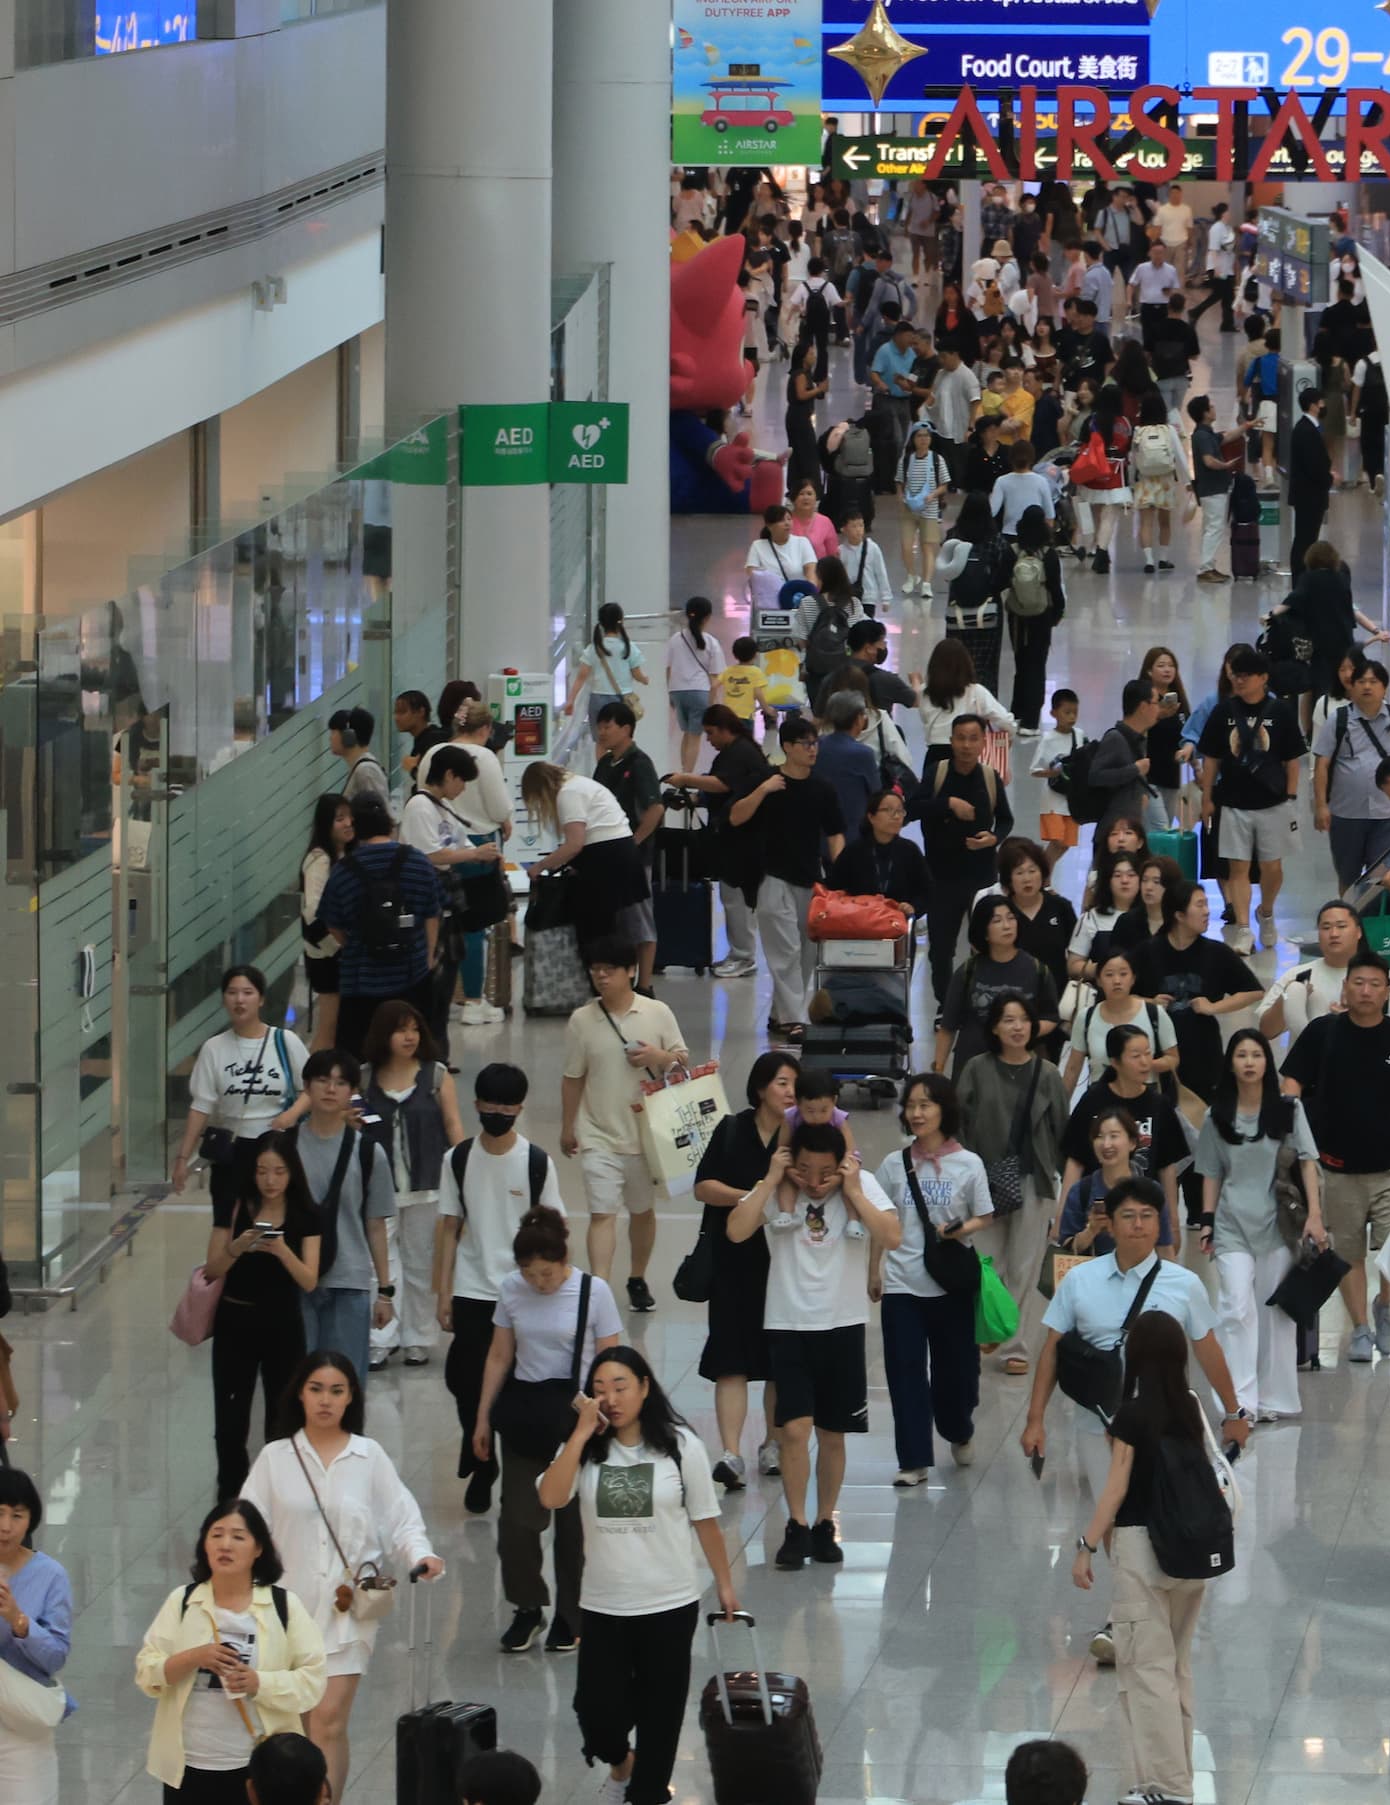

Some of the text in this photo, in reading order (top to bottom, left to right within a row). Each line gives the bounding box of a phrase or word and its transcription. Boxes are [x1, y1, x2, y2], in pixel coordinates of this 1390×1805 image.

[705, 8, 791, 17] DUTYFREE APP
[961, 54, 1137, 80] Food Court, 美食街
[736, 140, 777, 150] AIRSTAR
[494, 428, 534, 446] AED
[567, 454, 606, 469] AED
[520, 706, 543, 718] AED
